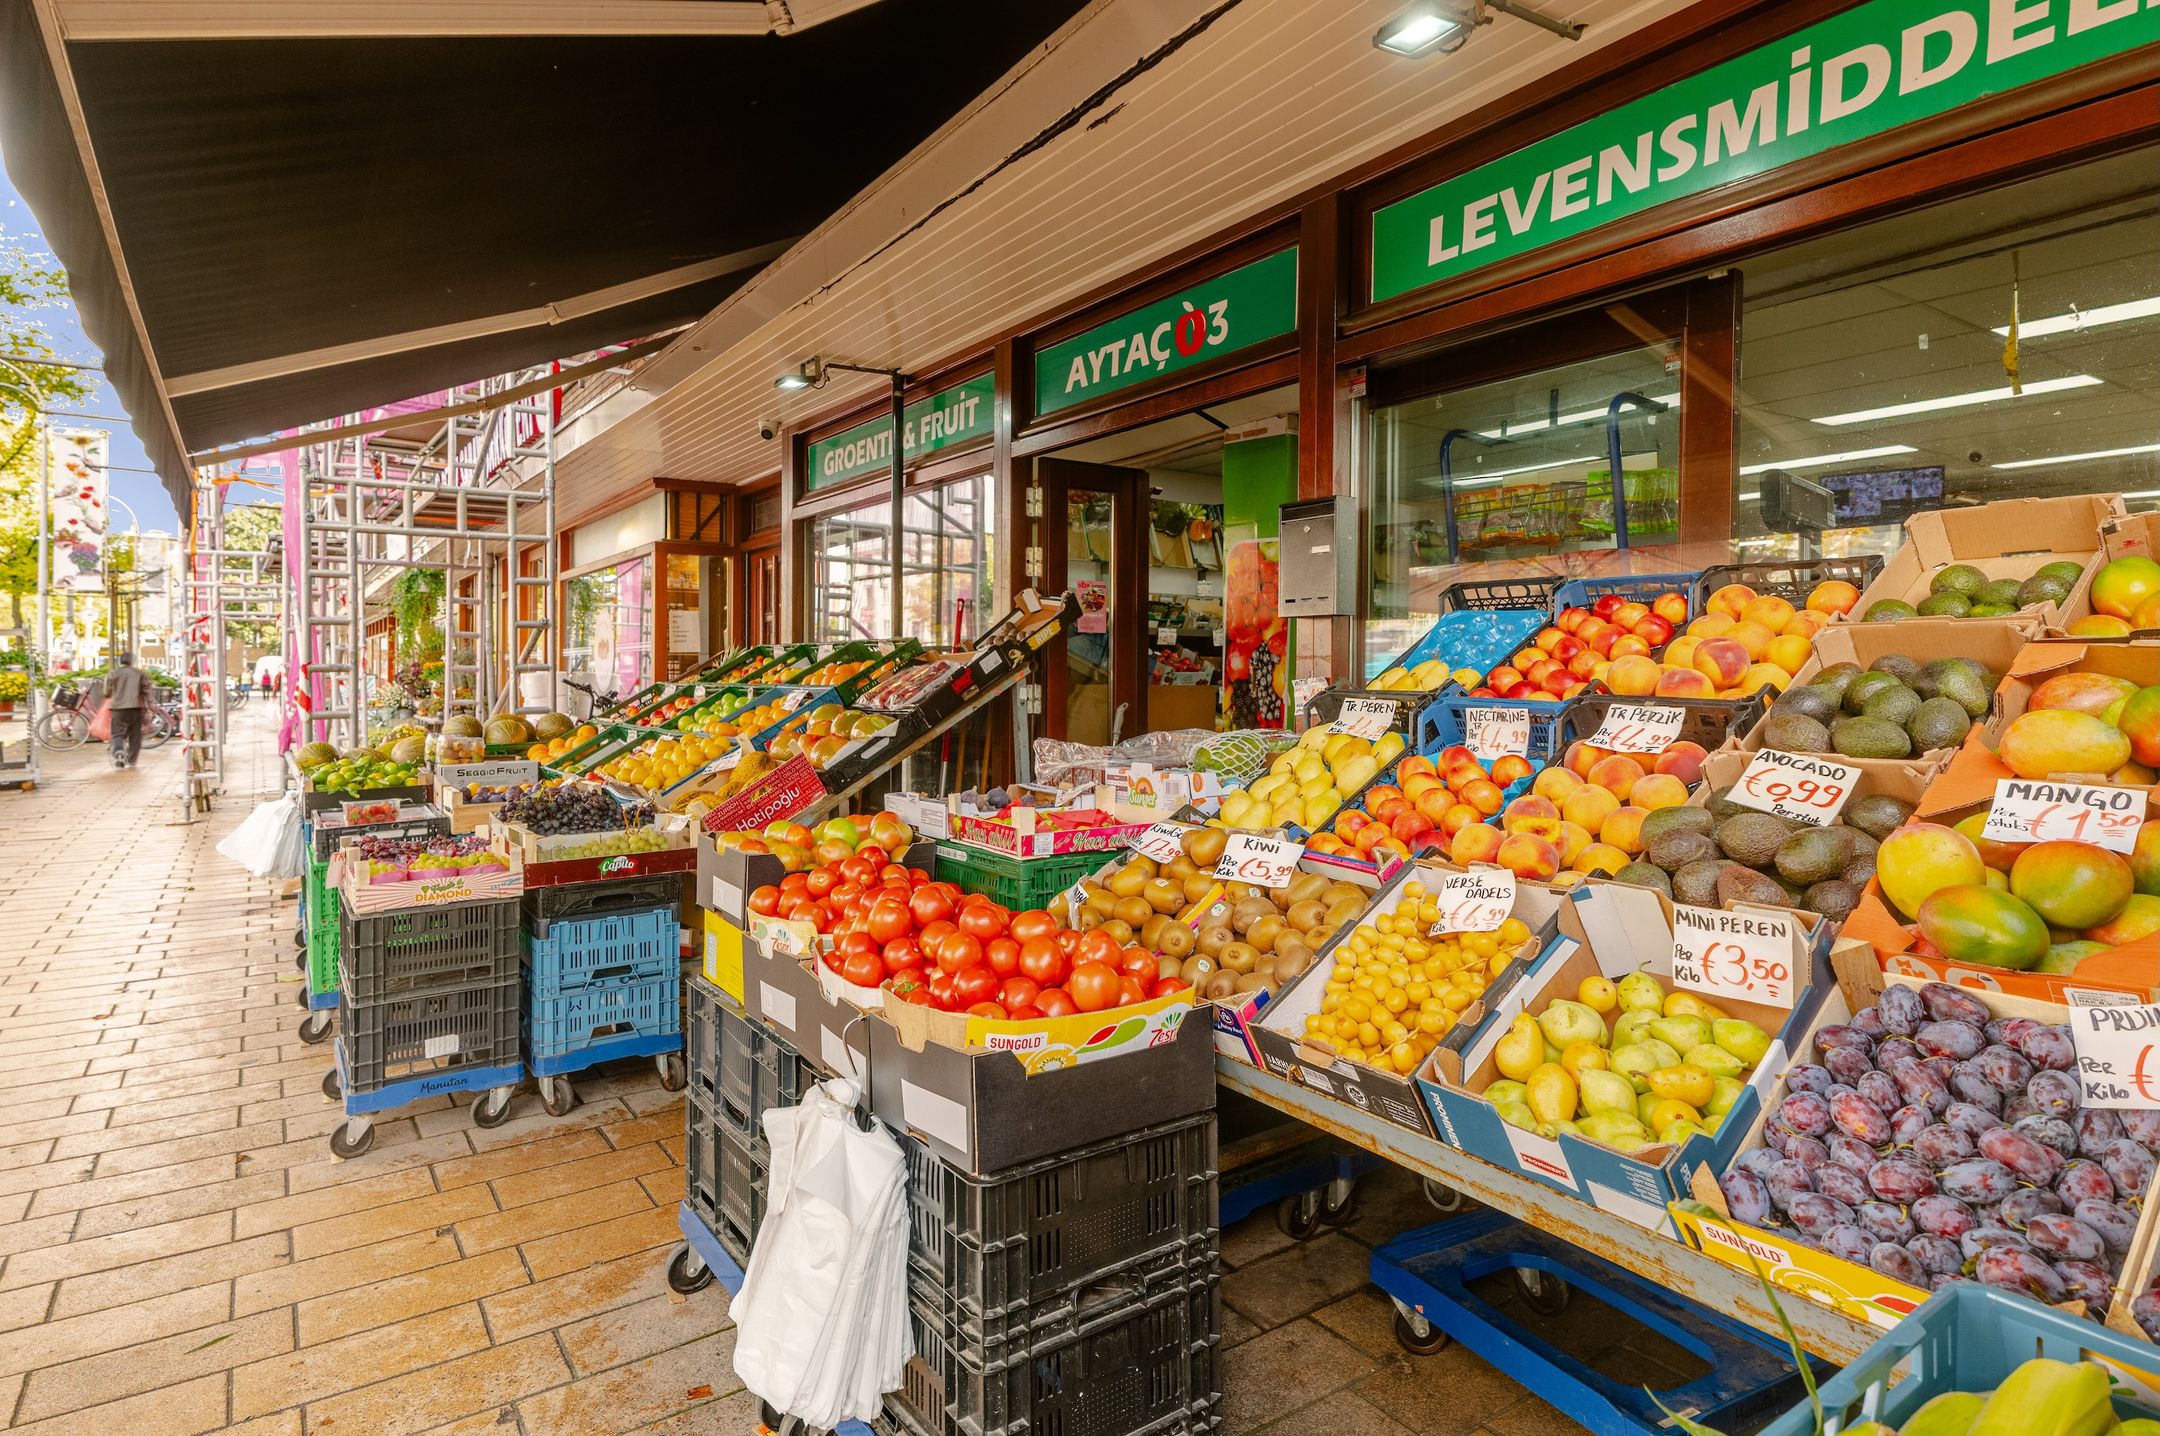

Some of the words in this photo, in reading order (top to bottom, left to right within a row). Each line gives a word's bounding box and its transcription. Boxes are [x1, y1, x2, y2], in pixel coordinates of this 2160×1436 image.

[824, 430, 893, 476] GROENT
[496, 767, 528, 775] FRUIT
[1754, 750, 1847, 781] AVOCADO
[2005, 782, 2133, 811] MANGO
[735, 786, 801, 832] Hatipoğlu
[1445, 874, 1484, 889] VERSE
[1465, 886, 1512, 900] DADELS
[1719, 916, 1787, 938] PEREN
[1674, 965, 1701, 983] Kilo
[1700, 941, 1789, 992] €3,50
[420, 1077, 469, 1094] Manutan
[2085, 1082, 2131, 1100] Kilo
